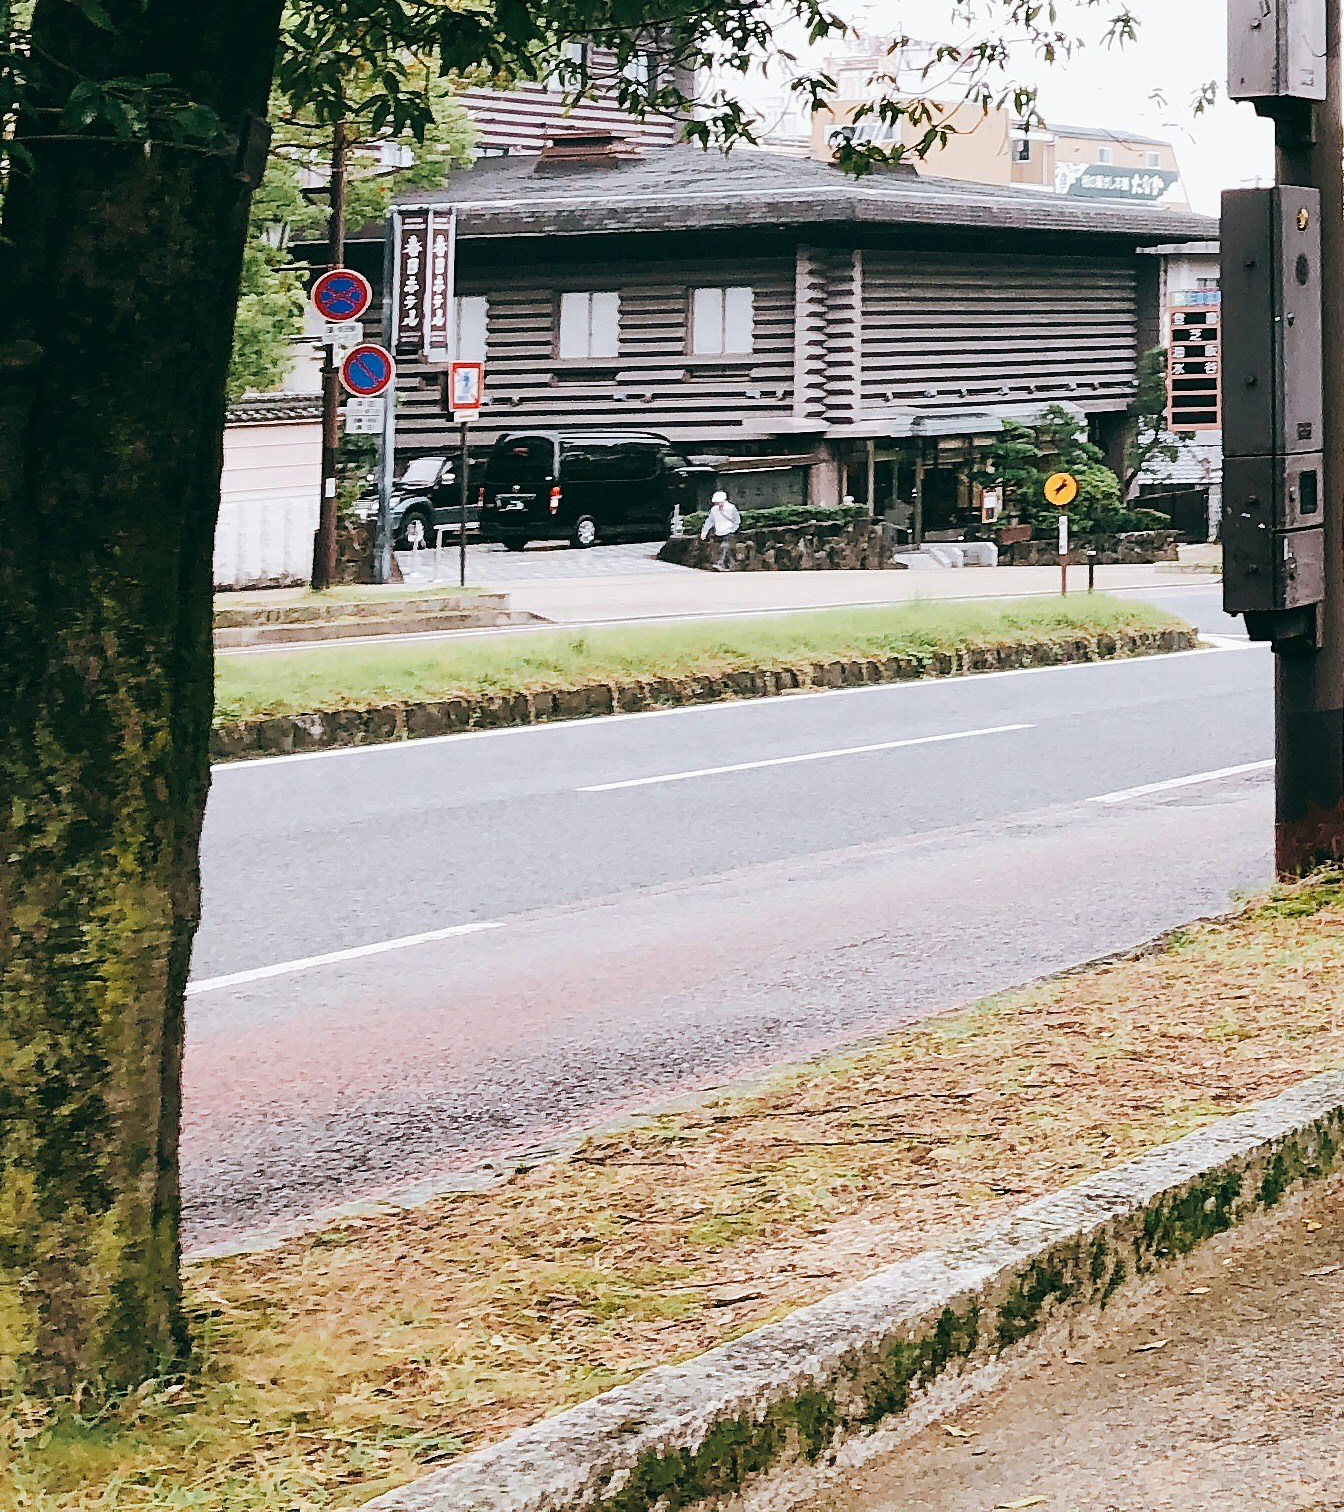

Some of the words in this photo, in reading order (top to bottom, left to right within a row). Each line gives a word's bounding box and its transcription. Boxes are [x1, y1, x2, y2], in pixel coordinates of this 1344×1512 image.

[401, 234, 423, 327] 春日ホテル
[431, 234, 448, 327] 春日ホテル
